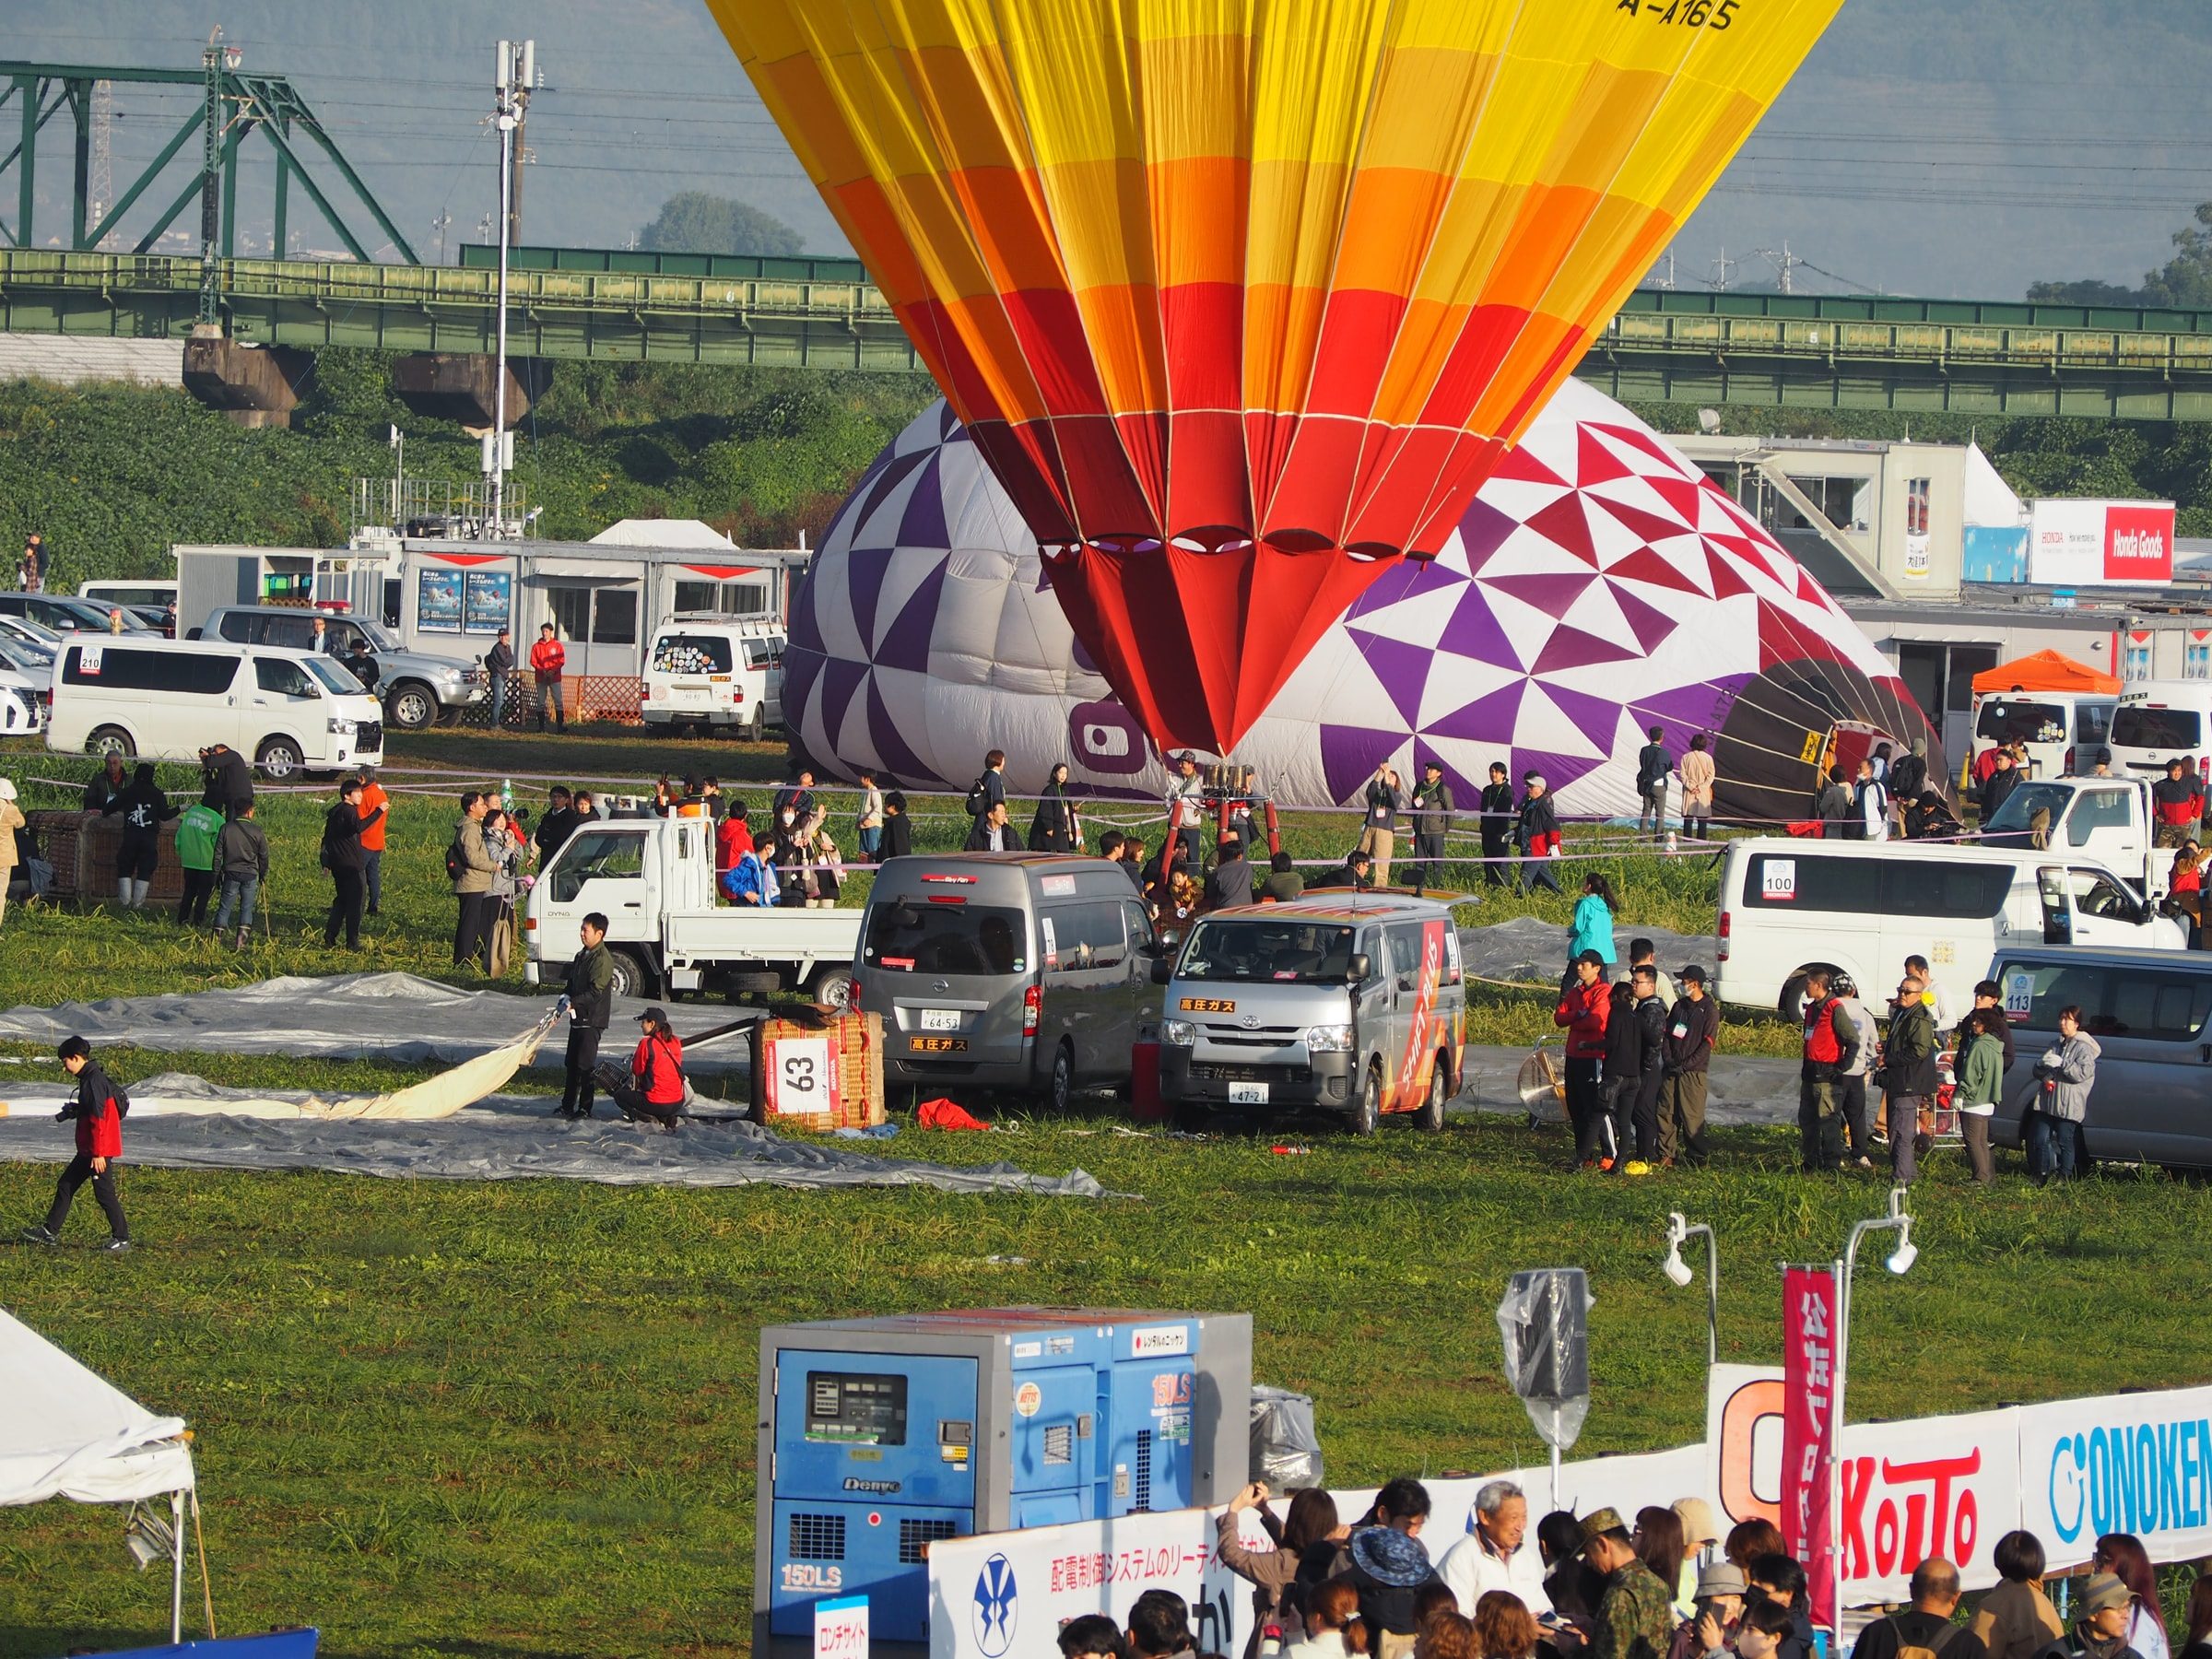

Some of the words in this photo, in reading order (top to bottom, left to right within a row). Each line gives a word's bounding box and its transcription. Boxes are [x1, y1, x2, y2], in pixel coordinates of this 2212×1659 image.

[2042, 532, 2064, 544] HONDA
[2113, 529, 2137, 558] Honda
[2139, 529, 2163, 559] Goods
[82, 658, 100, 668] 210
[1767, 877, 1792, 889] 100
[1181, 999, 1234, 1012] 高圧ガス
[2007, 994, 2030, 1012] 113
[1402, 1003, 1426, 1092] SHIFT
[1422, 932, 1438, 1011] PLUS
[929, 1018, 958, 1029] 64-53
[912, 1039, 967, 1051] 高圧ガス
[785, 1057, 814, 1092] 63
[1238, 1091, 1265, 1102] 47-21
[1143, 1335, 1184, 1348] レンタルのニッケン
[1152, 1372, 1191, 1406] 150LS
[843, 1477, 901, 1495] Denyo
[782, 1563, 842, 1587] 150LS
[820, 1620, 865, 1652] ロンチサイト
